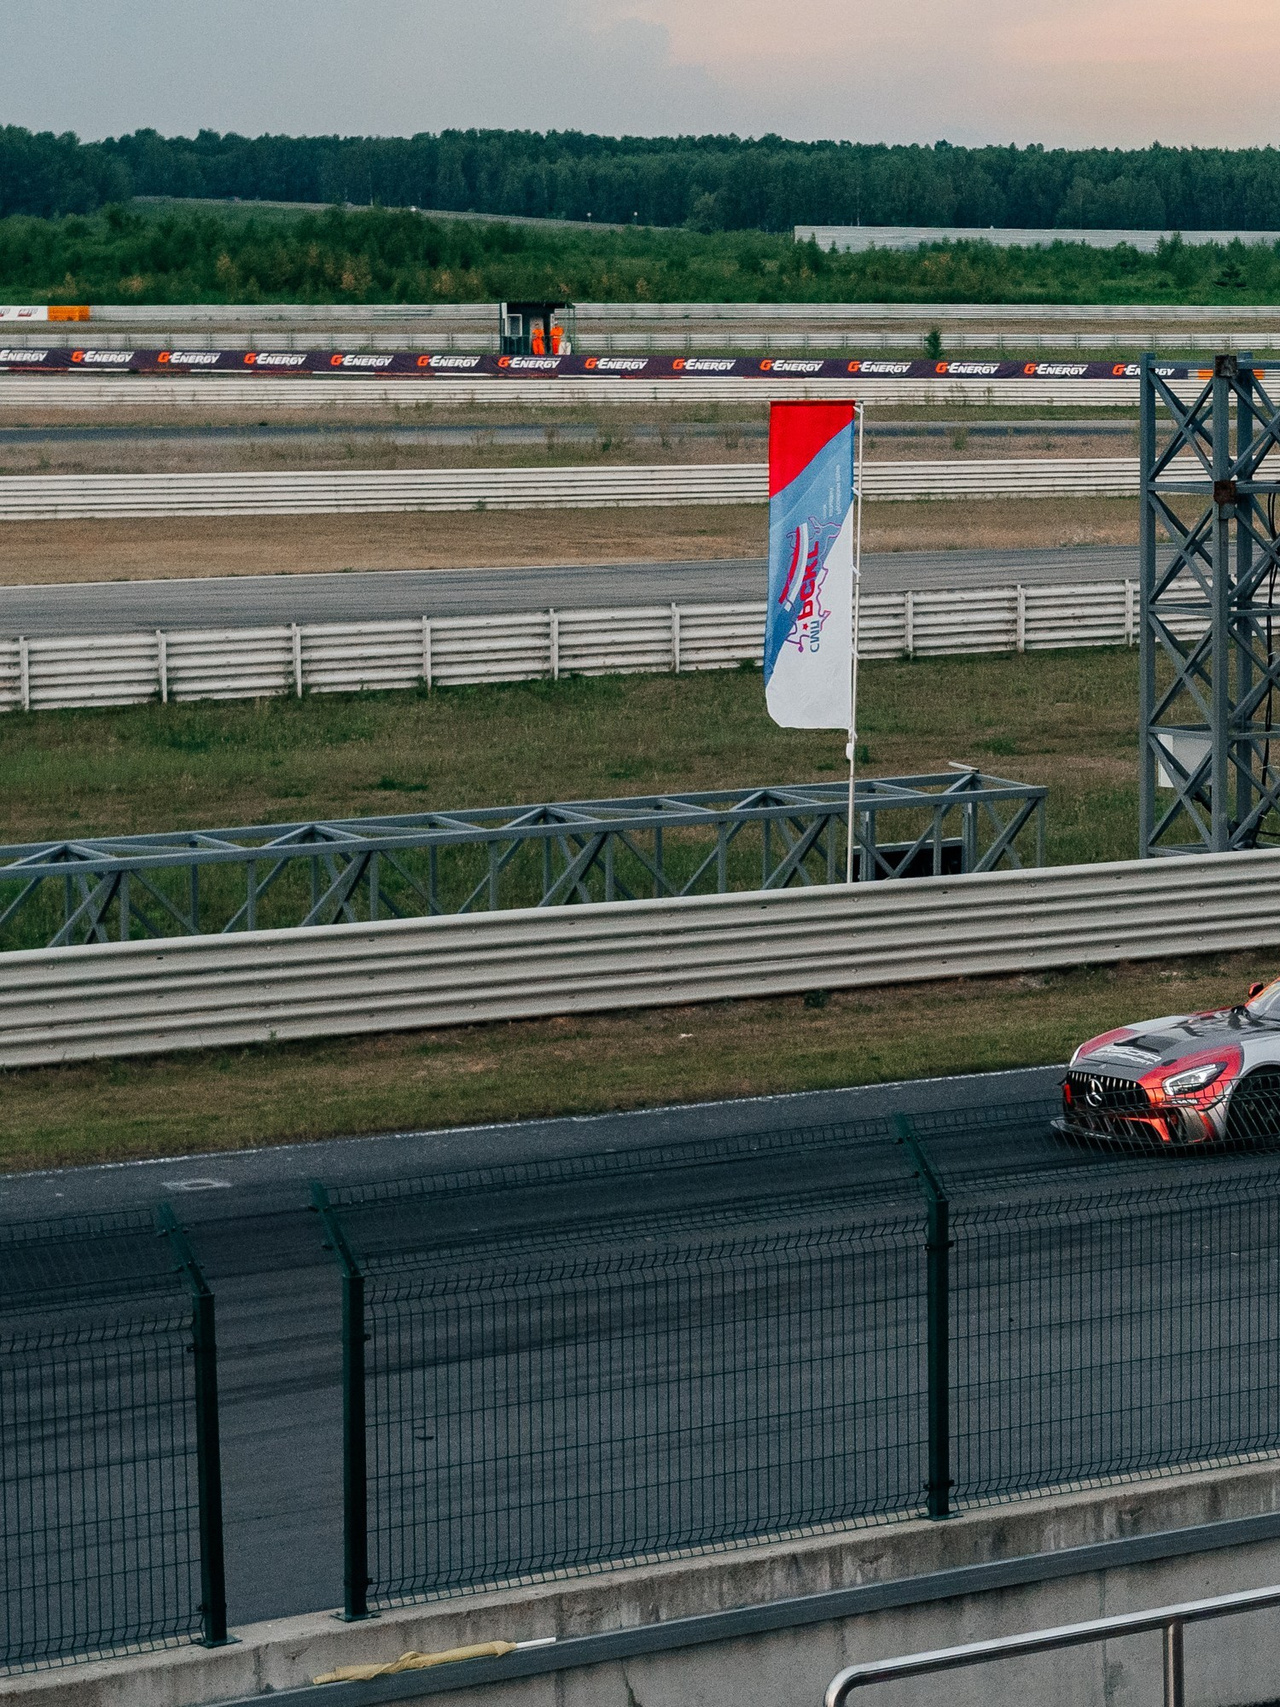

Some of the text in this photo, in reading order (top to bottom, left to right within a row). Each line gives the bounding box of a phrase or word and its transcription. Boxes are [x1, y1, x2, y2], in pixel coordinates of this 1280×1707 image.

[71, 351, 134, 363] G-ENERGY
[157, 352, 220, 364] G-ENERGY
[244, 353, 307, 365] G-ENERGY
[331, 355, 393, 367] G-ENERGY
[417, 355, 480, 368] G-ENERGY
[498, 356, 561, 369] G-ENERGY
[585, 357, 648, 370] G-ENERGY
[673, 358, 736, 371] G-ENERGY
[760, 359, 824, 372] G-ENERGY
[848, 360, 911, 374] G-ENERGY
[936, 362, 1000, 375] G-ENERGY
[1024, 363, 1088, 376] G-ENERGY
[1112, 364, 1175, 376] G-ENGY
